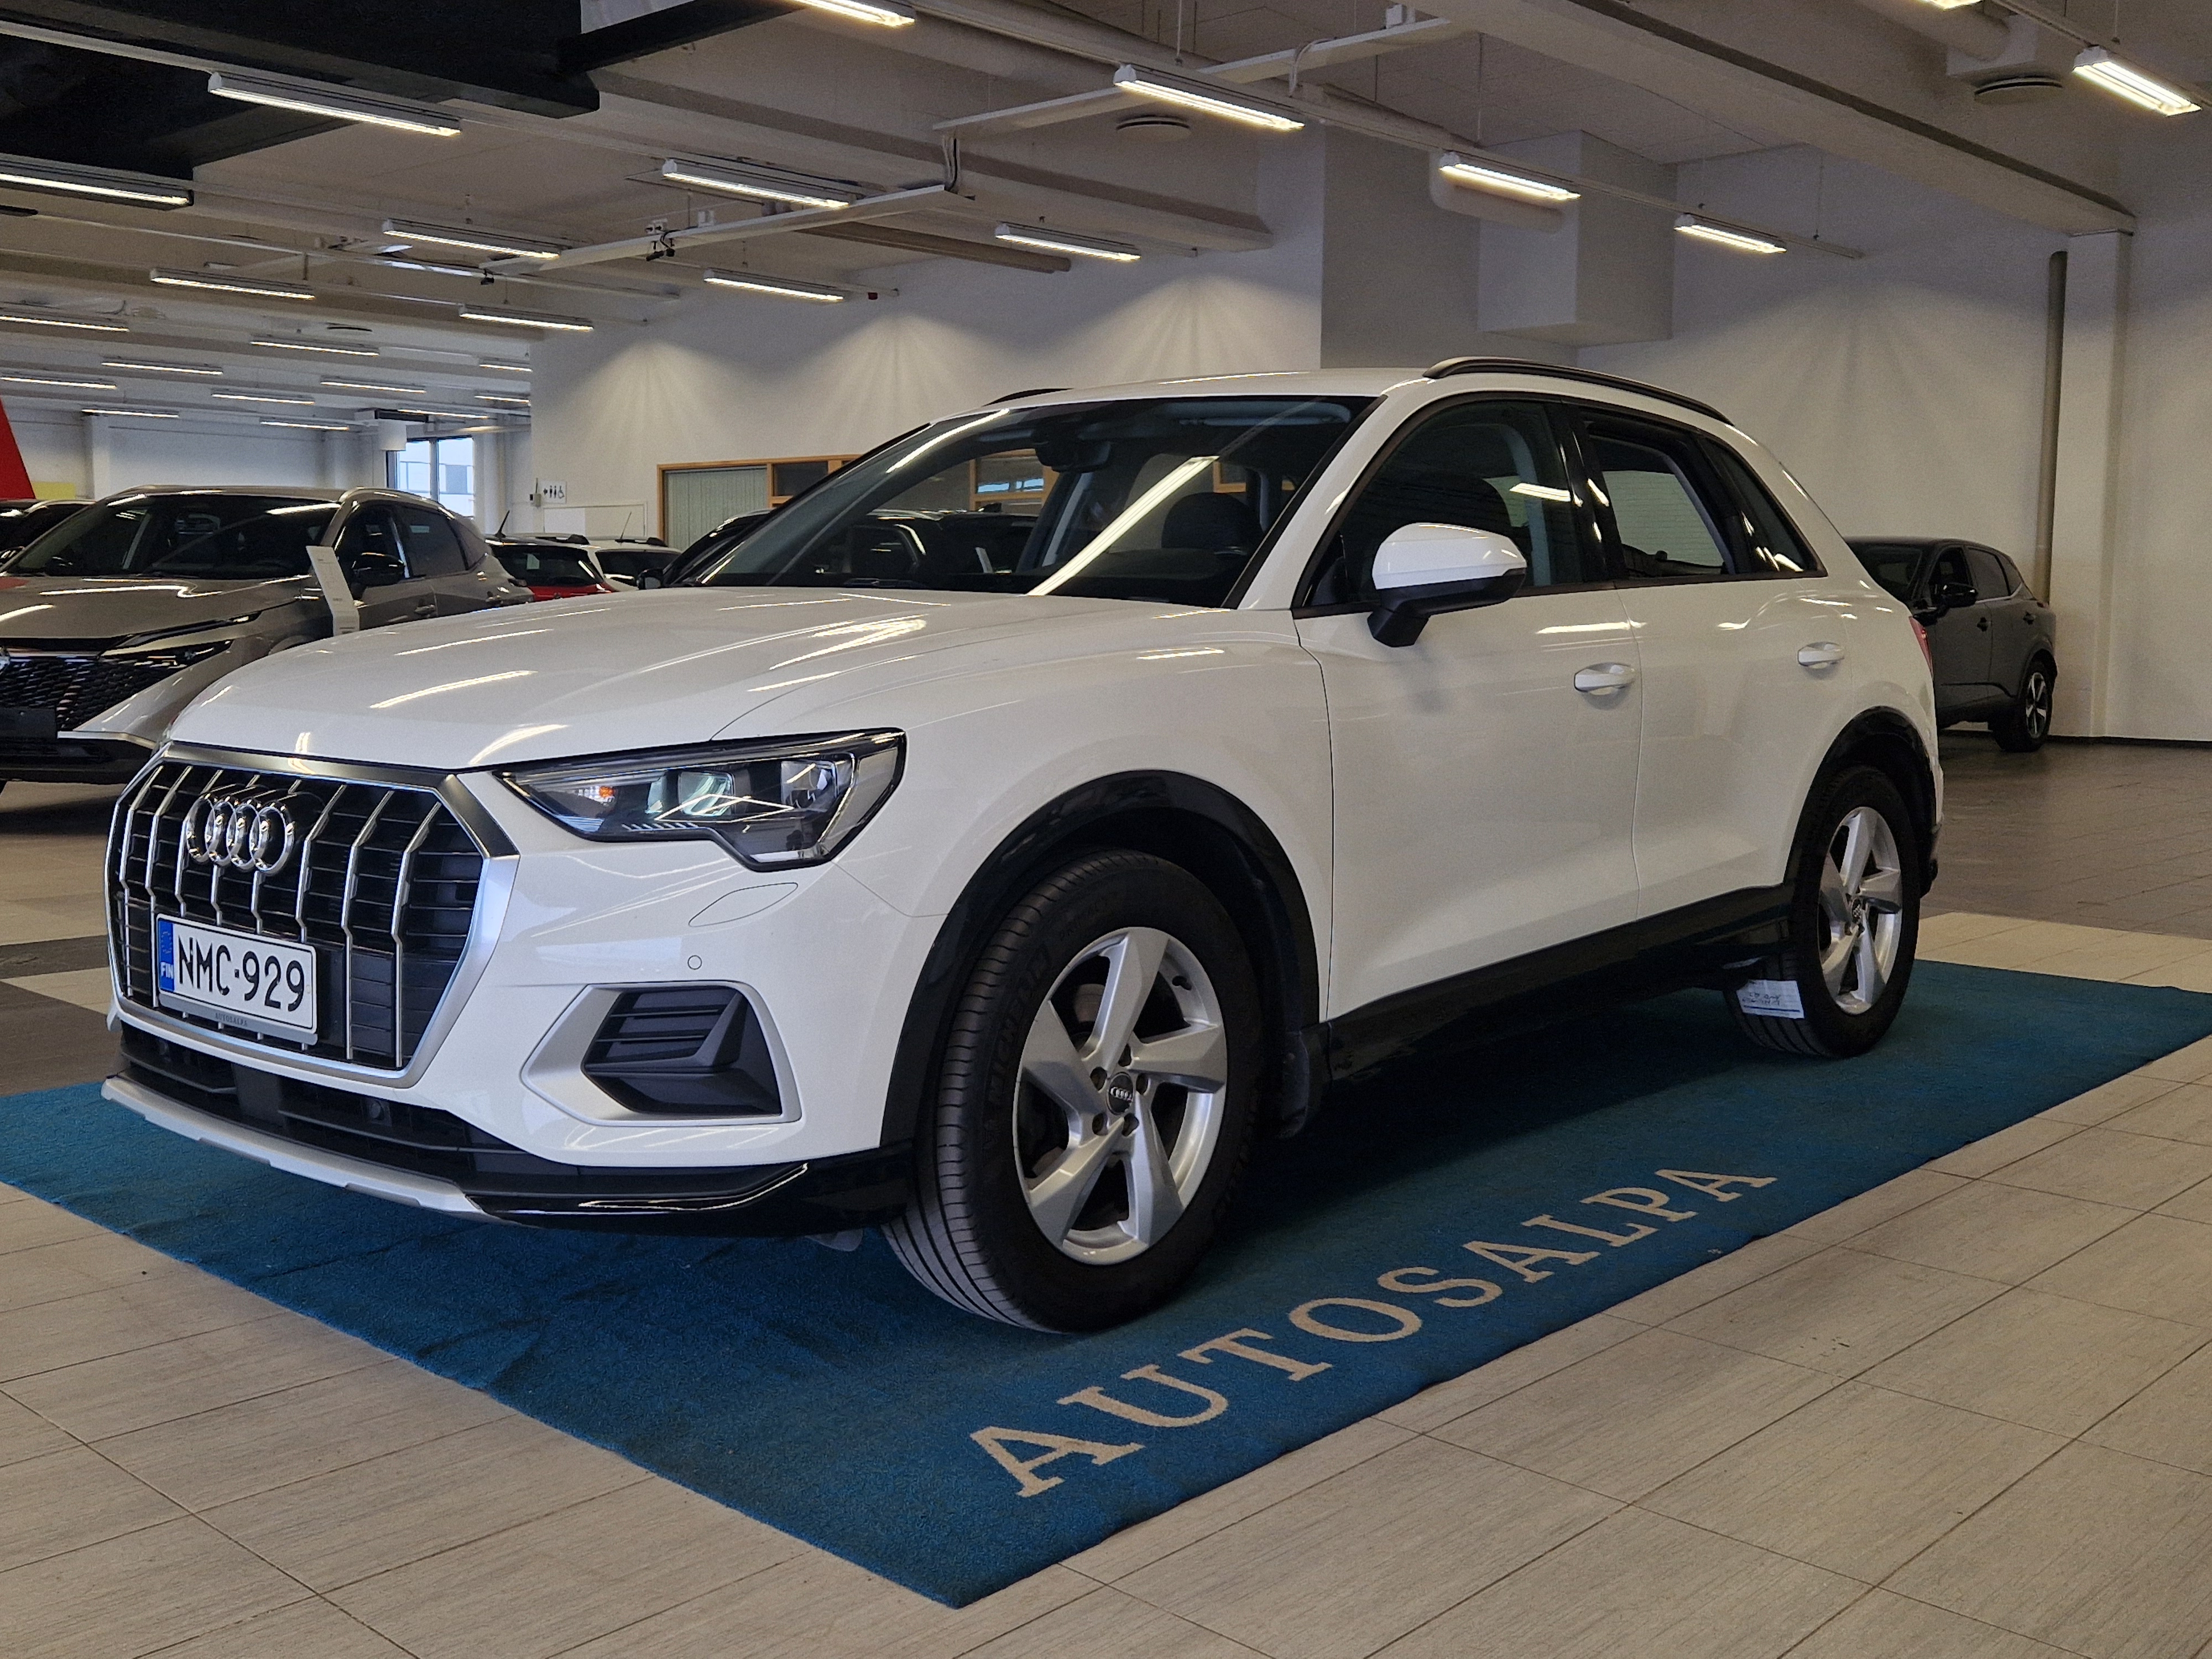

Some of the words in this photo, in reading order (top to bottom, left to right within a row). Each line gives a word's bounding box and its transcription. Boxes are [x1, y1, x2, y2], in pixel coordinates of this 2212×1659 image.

[160, 962, 174, 979] FIN
[178, 935, 305, 1012] NMC-929
[215, 1012, 248, 1027] AUTOSALPA
[969, 1168, 1777, 1497] AUTOSALPA
